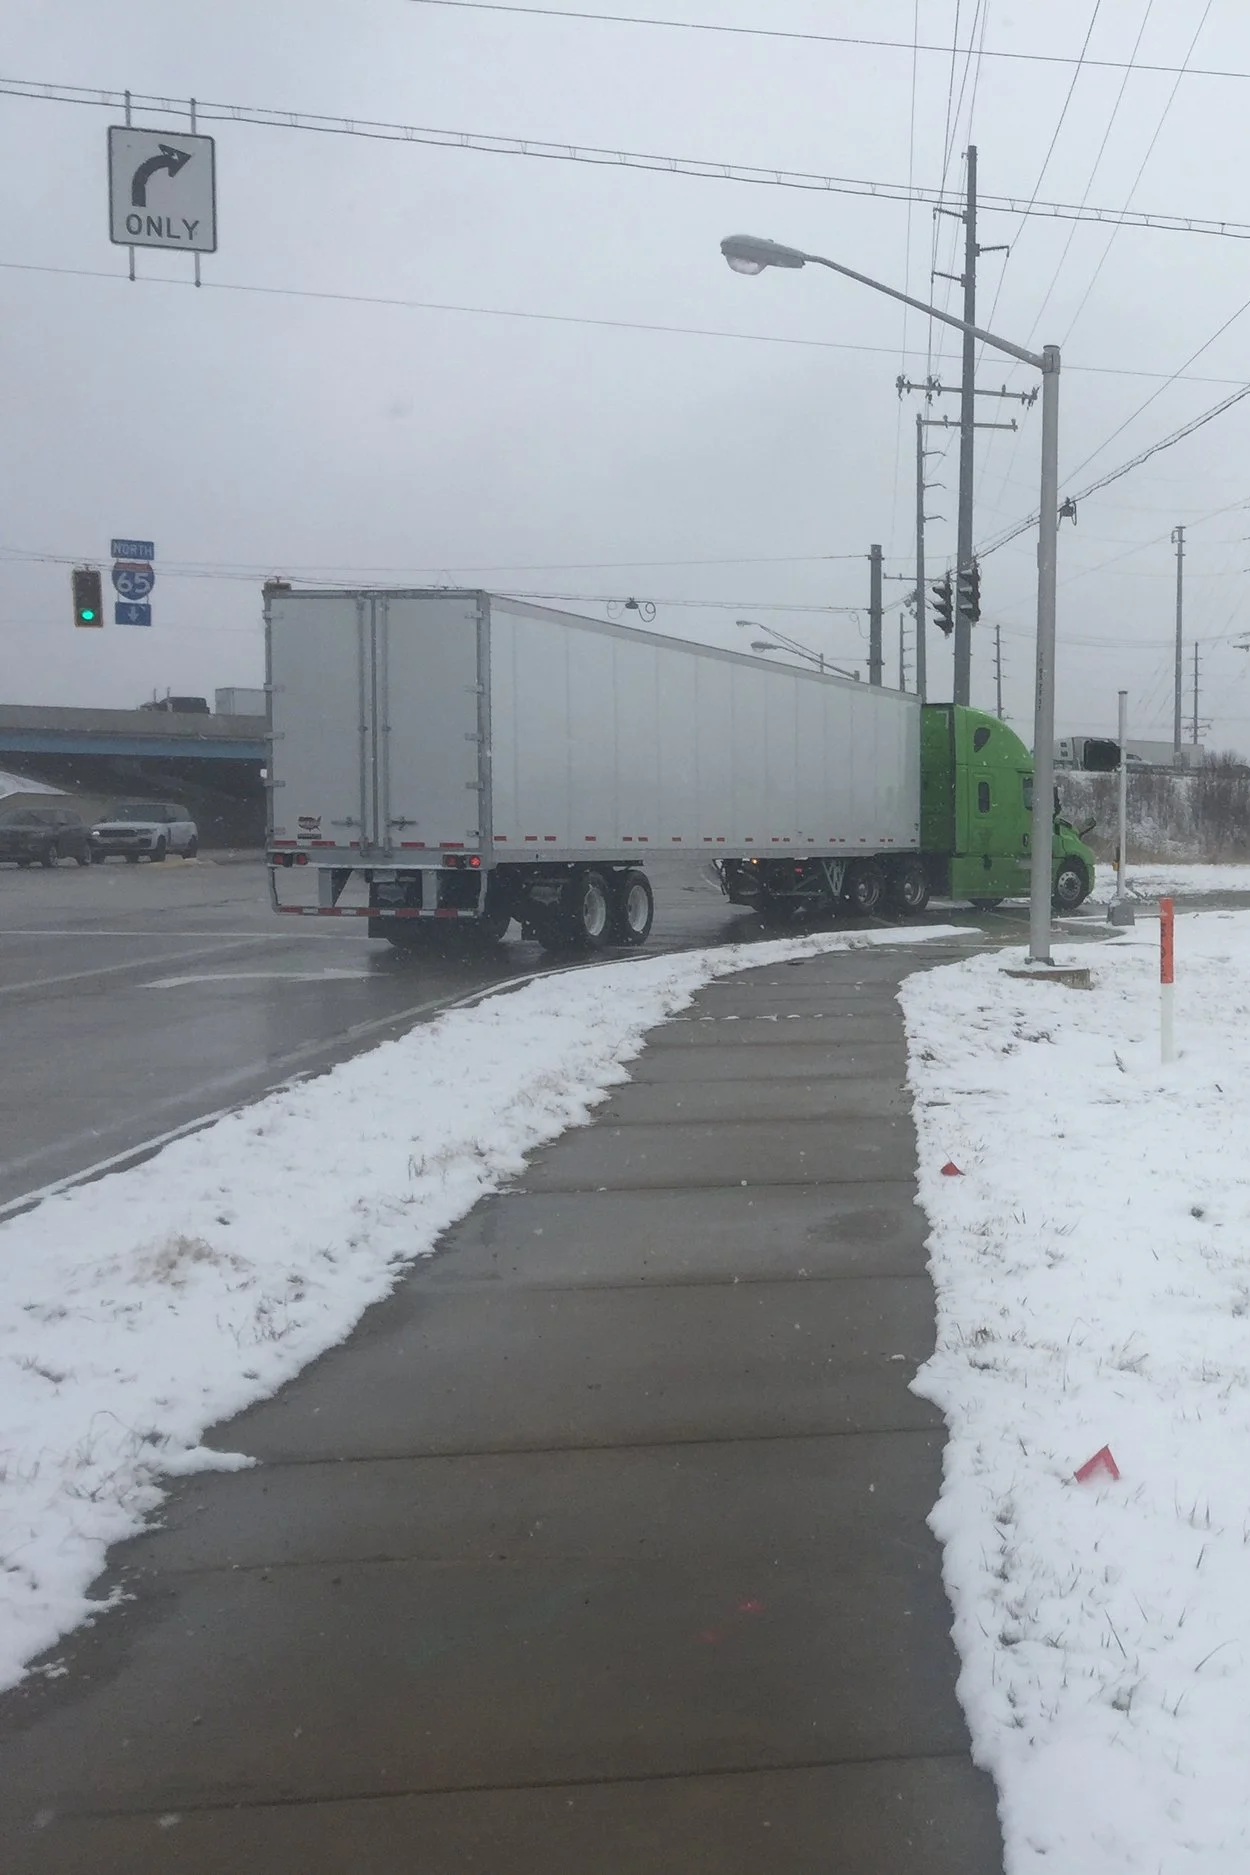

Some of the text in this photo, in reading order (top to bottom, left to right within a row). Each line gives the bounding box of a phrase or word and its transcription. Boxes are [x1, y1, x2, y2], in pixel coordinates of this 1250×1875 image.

[125, 213, 200, 241] ONLY
[113, 542, 153, 557] NORTH
[117, 572, 151, 593] 65
